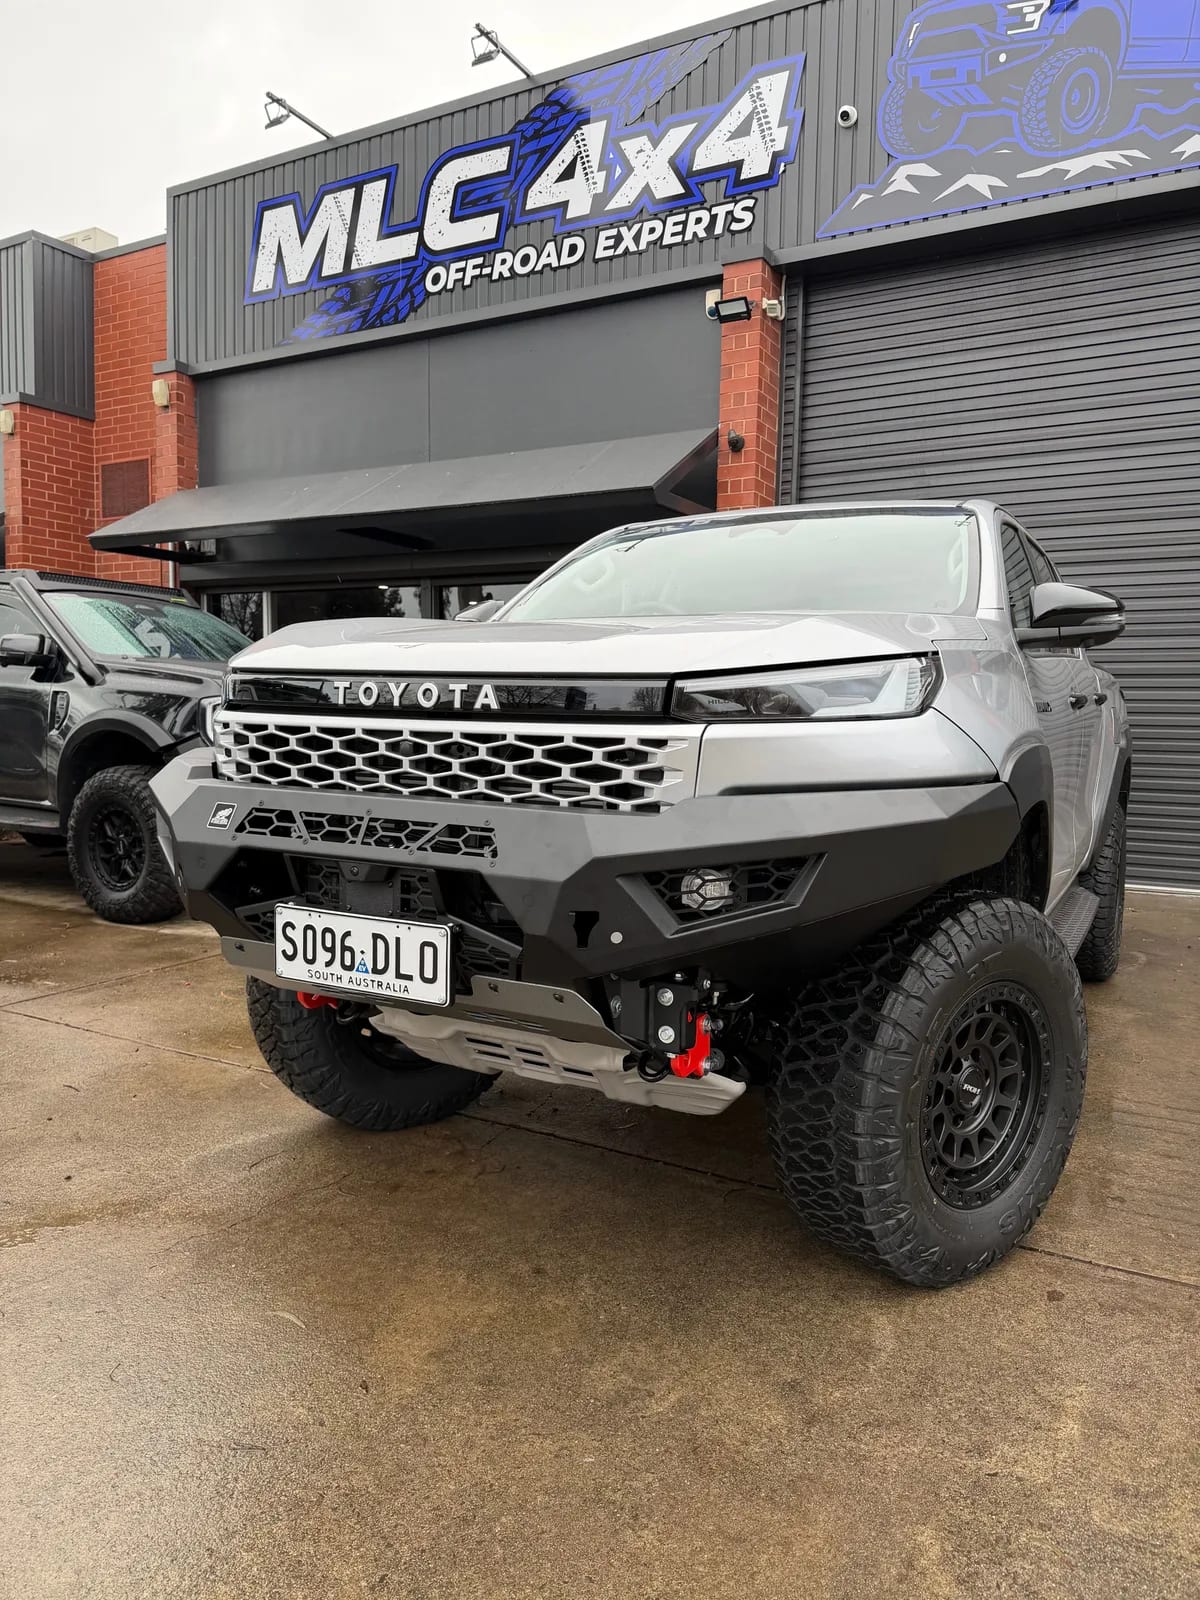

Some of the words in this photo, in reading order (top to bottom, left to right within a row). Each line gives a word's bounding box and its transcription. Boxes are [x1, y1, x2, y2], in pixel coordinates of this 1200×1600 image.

[253, 146, 511, 293] MLC
[525, 70, 790, 220] 4x4
[424, 235, 585, 293] OFF-ROAD
[594, 198, 756, 260] EXPERTS
[333, 680, 501, 710] TOYOTA
[307, 968, 343, 984] SOUTH
[347, 976, 410, 995] AUSTRALIA
